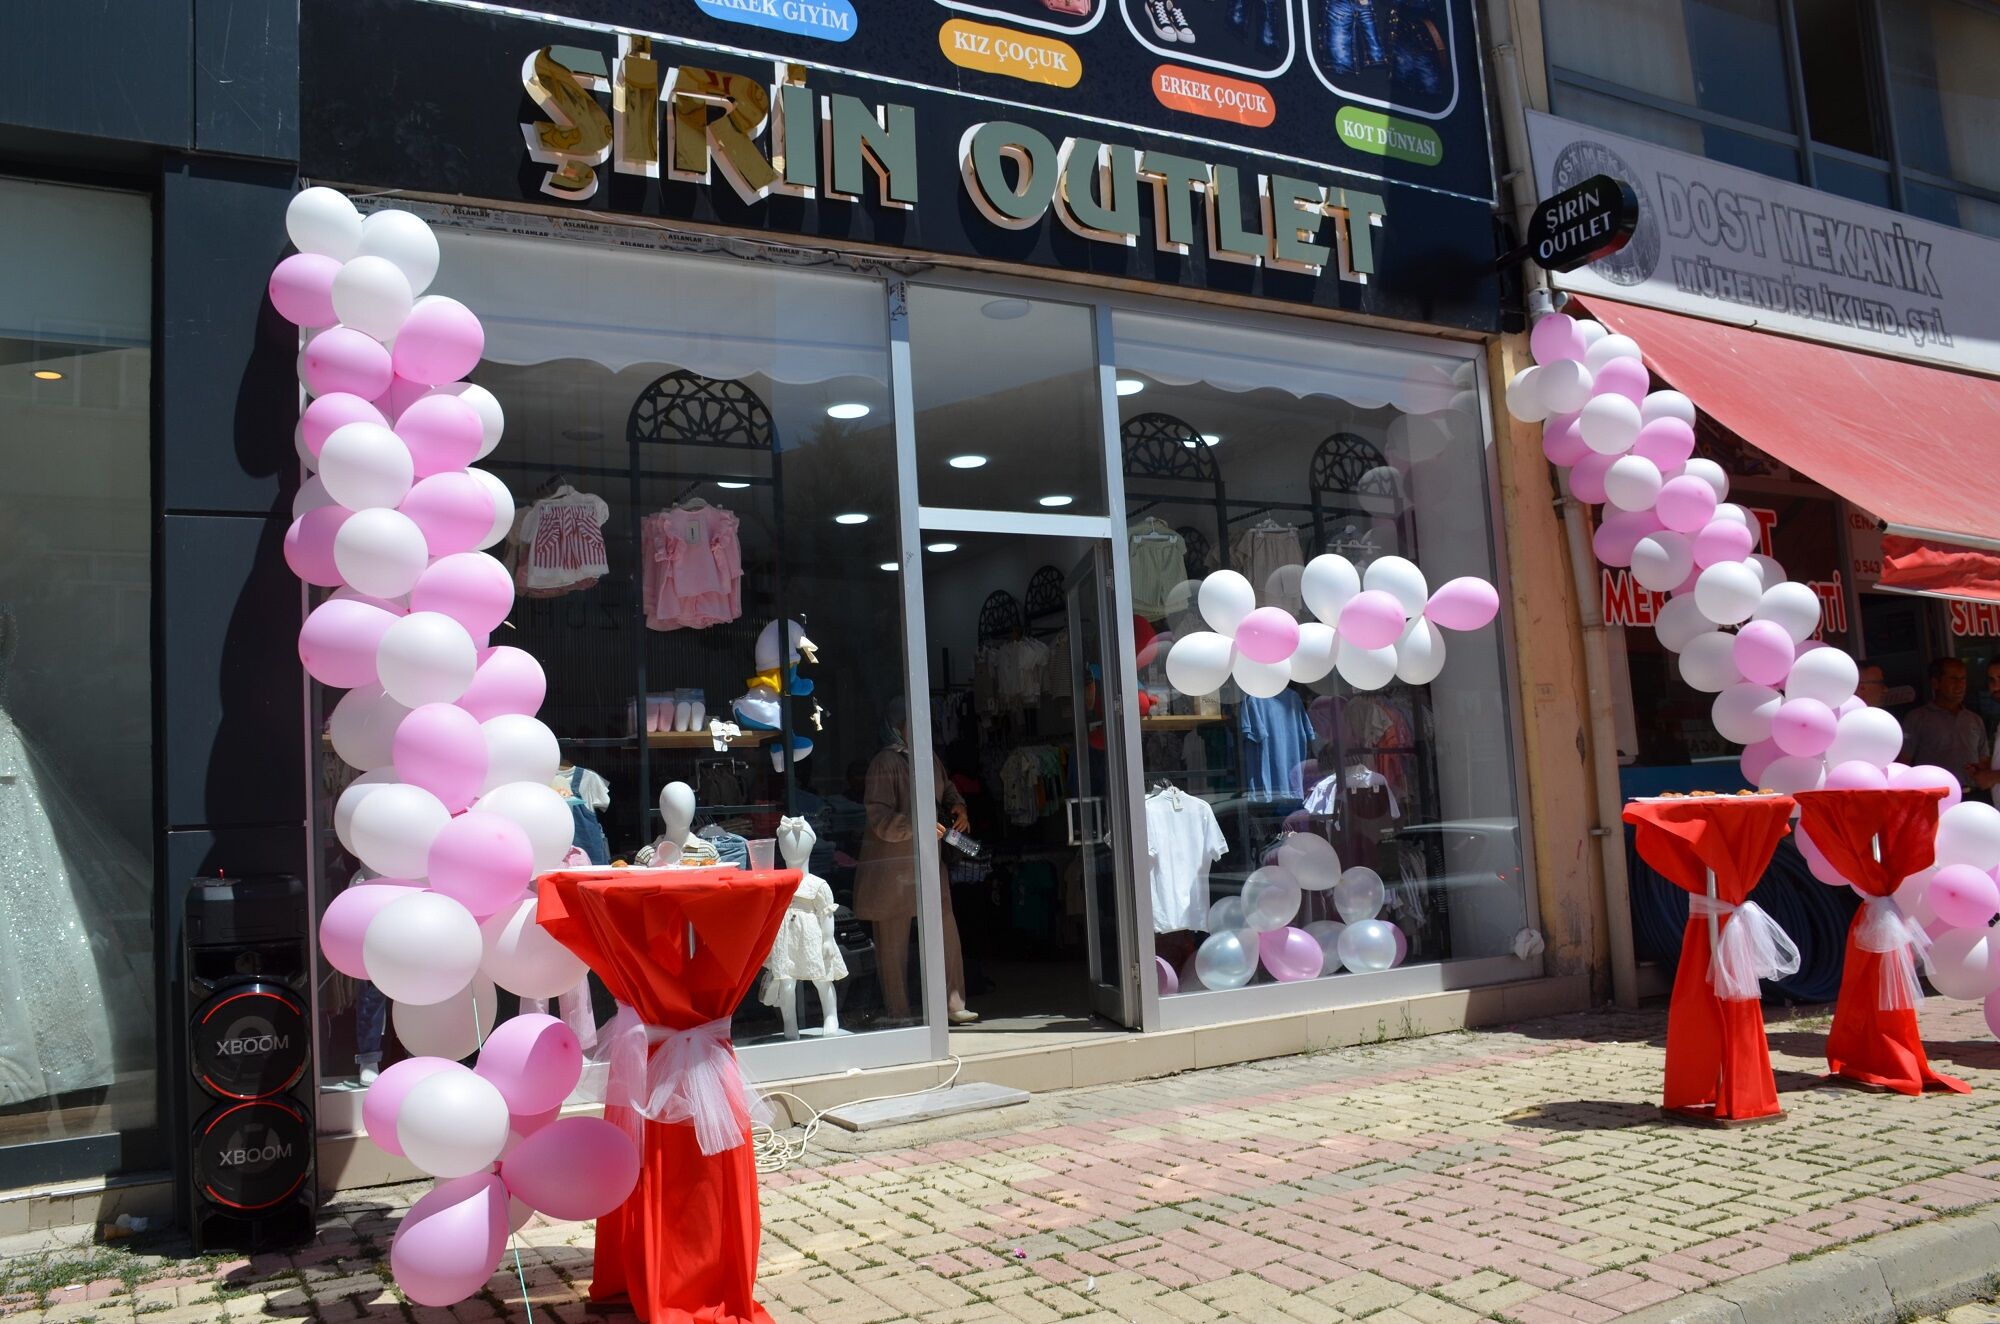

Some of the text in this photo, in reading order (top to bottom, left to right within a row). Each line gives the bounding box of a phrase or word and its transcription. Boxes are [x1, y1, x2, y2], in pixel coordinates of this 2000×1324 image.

[782, 0, 849, 31] GİYİM
[953, 30, 1069, 72] KIZ ÇOÇUK
[1160, 75, 1268, 113] ERKEK ÇOÇUK
[1343, 119, 1437, 157] KOT DÜNYASI
[521, 34, 1388, 284] ŞİRİN OUTLET
[563, 221, 599, 231] ASLANLAR
[1546, 188, 1600, 233] ŞİRİN
[668, 233, 703, 243] ASLANLAR
[1539, 211, 1611, 259] OUTLET
[1656, 172, 1944, 300] DOST MEKANİK
[1671, 254, 1954, 348] MÜHENDİSLİK LTD. ŞTİ.
[1949, 600, 2000, 637] SIH
[216, 1034, 289, 1056] XBOOM
[220, 1143, 293, 1166] XBOOM
